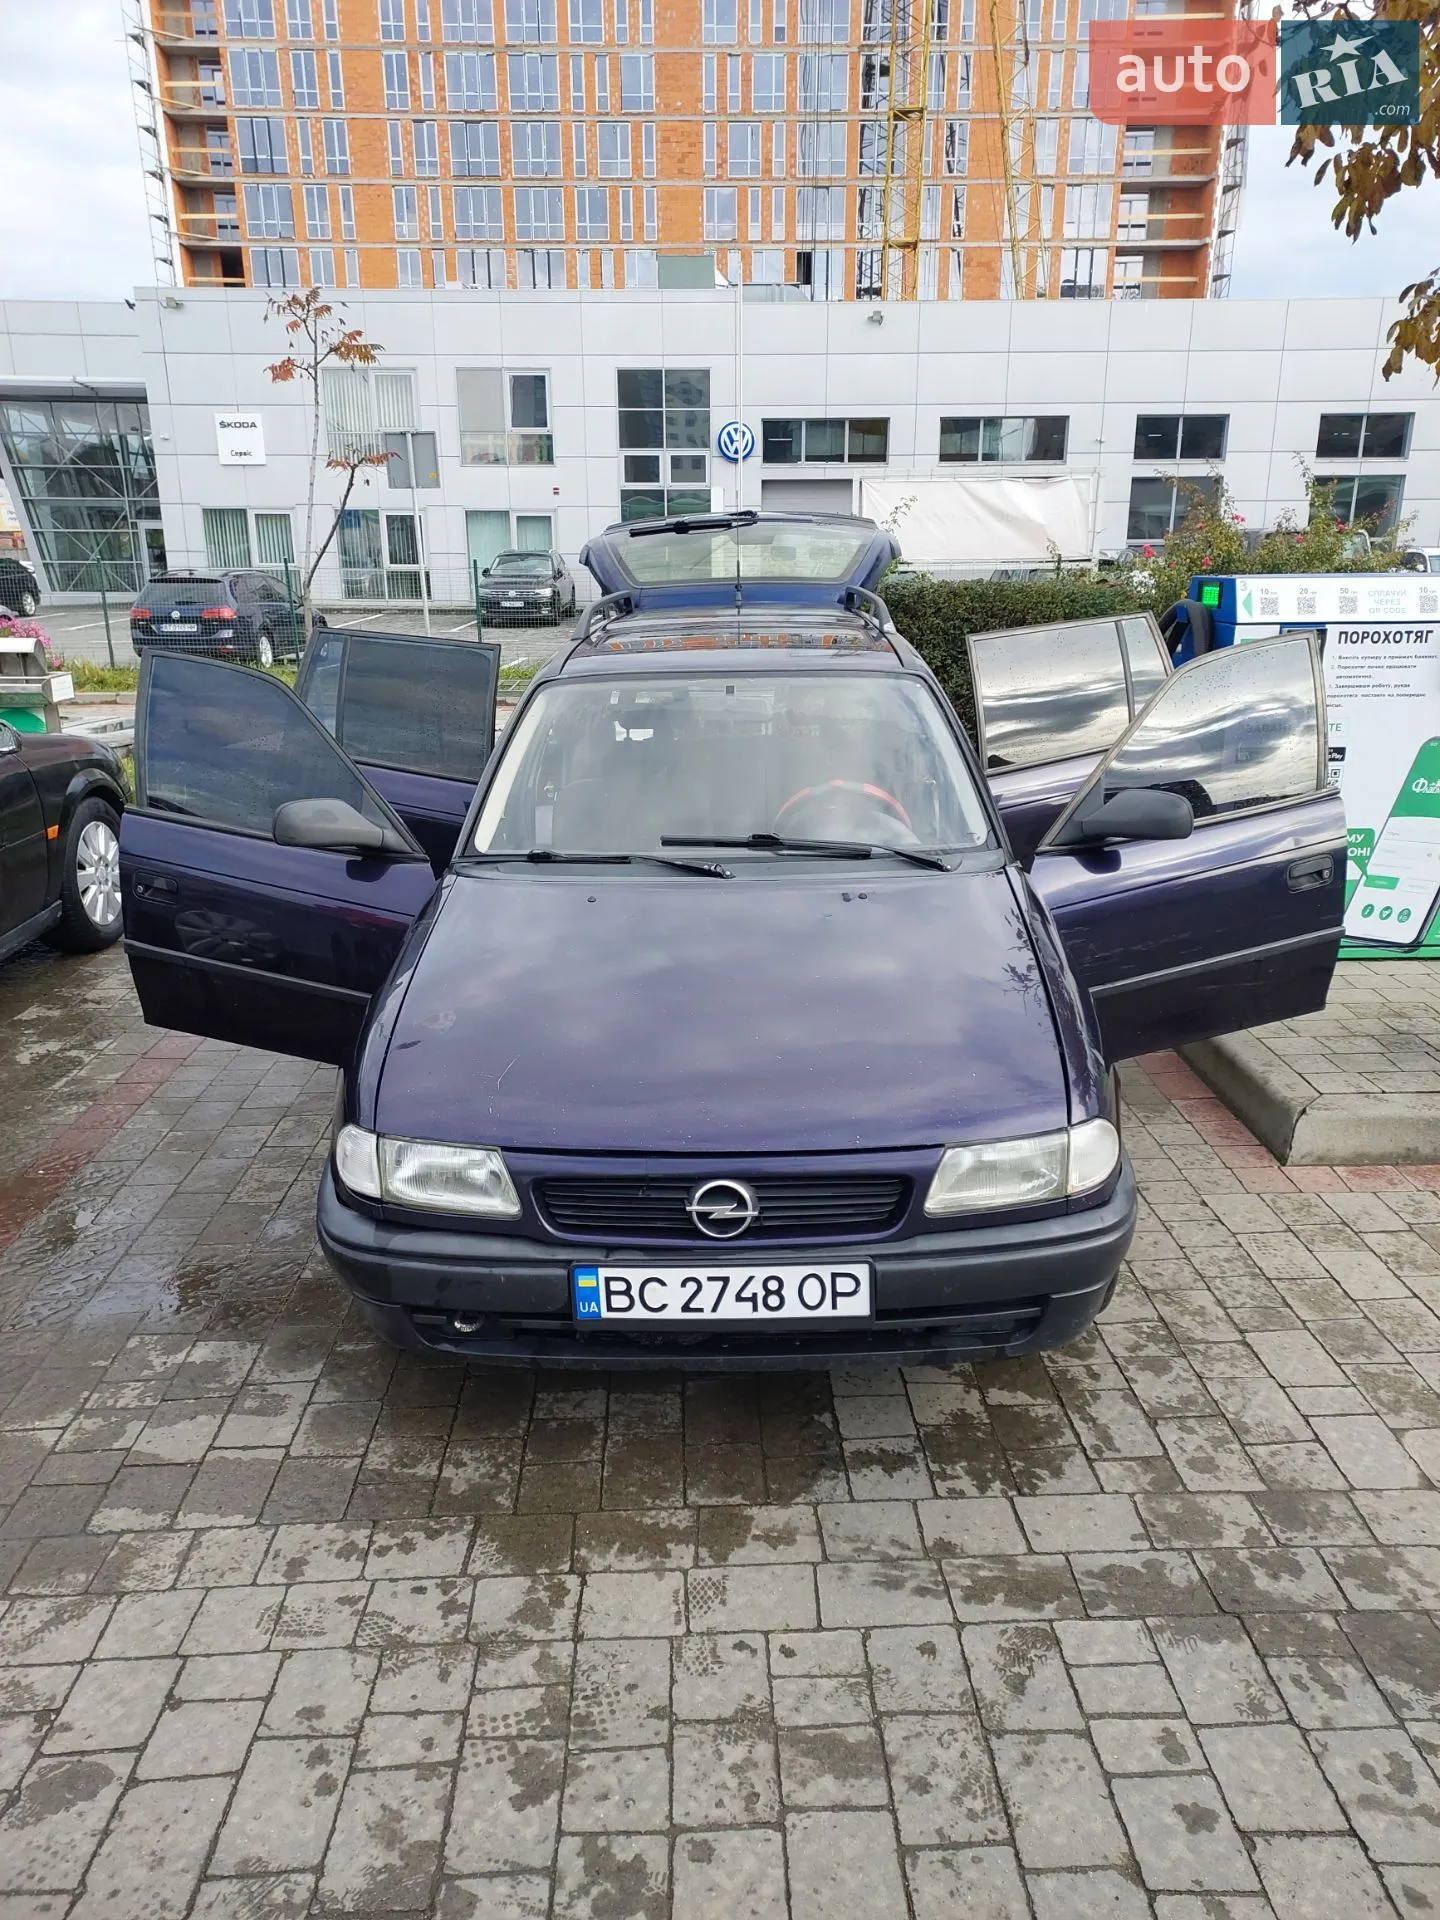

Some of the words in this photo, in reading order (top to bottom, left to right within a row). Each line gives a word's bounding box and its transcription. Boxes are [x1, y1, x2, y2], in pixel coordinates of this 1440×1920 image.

[1338, 630, 1434, 644] ПОРОХОТЯГ
[604, 1275, 669, 1313] BC
[680, 1275, 785, 1313] 2748
[797, 1272, 862, 1311] OP
[579, 1301, 599, 1313] UA
